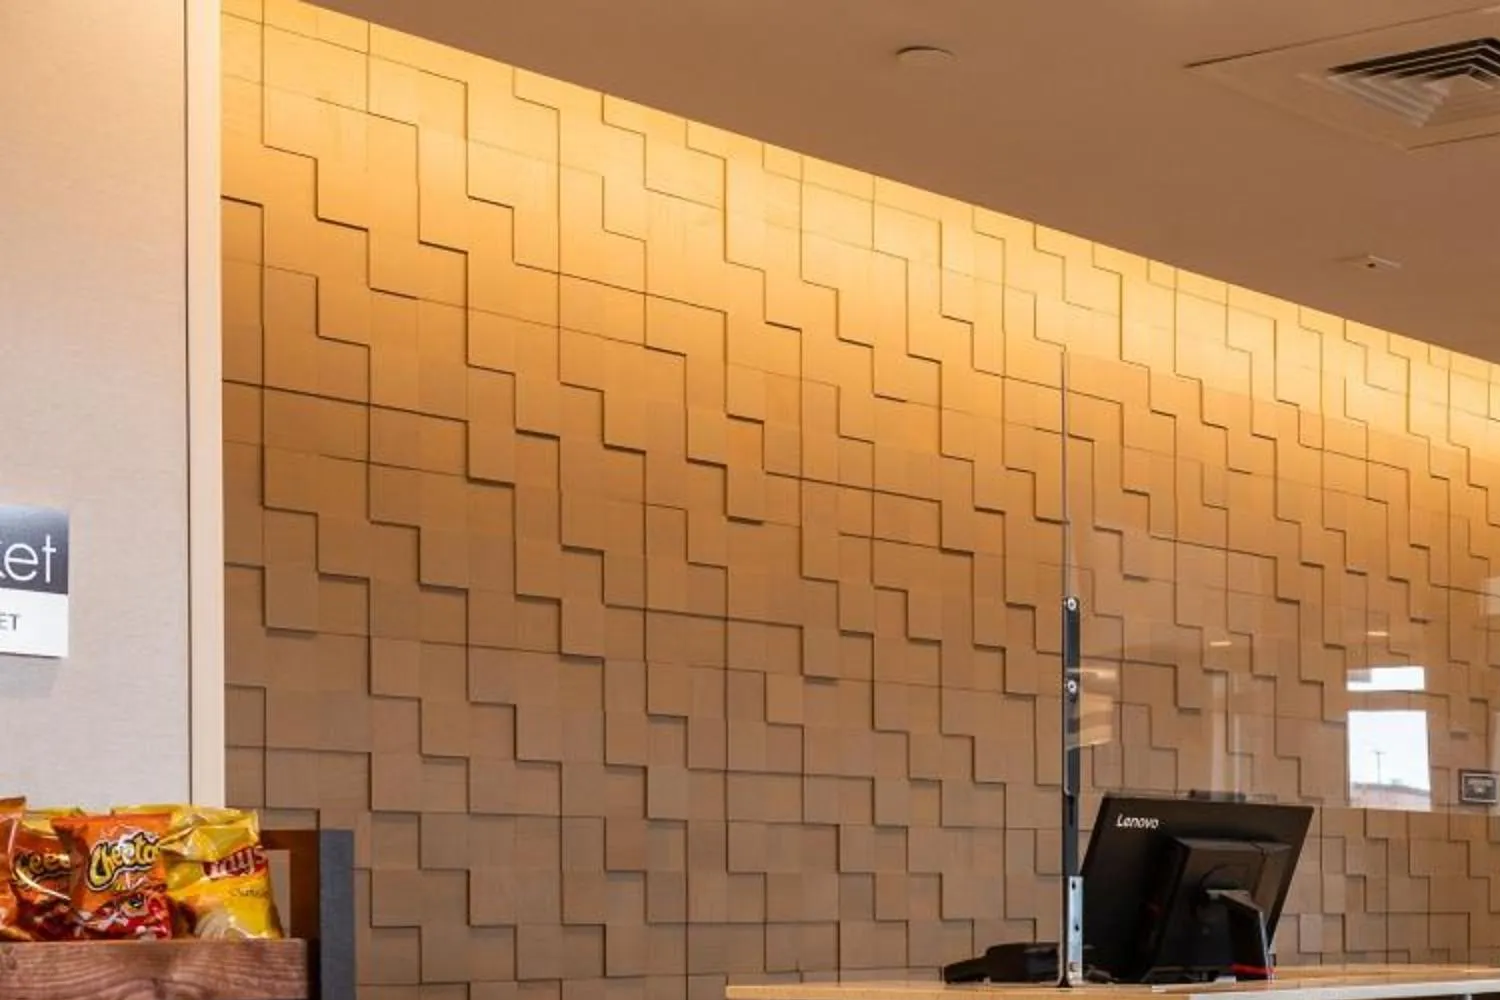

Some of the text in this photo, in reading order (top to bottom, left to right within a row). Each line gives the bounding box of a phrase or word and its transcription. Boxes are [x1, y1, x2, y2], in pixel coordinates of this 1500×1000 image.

[0, 534, 57, 583] et
[1116, 813, 1160, 830] Lenovo
[88, 831, 161, 888] Cheeto
